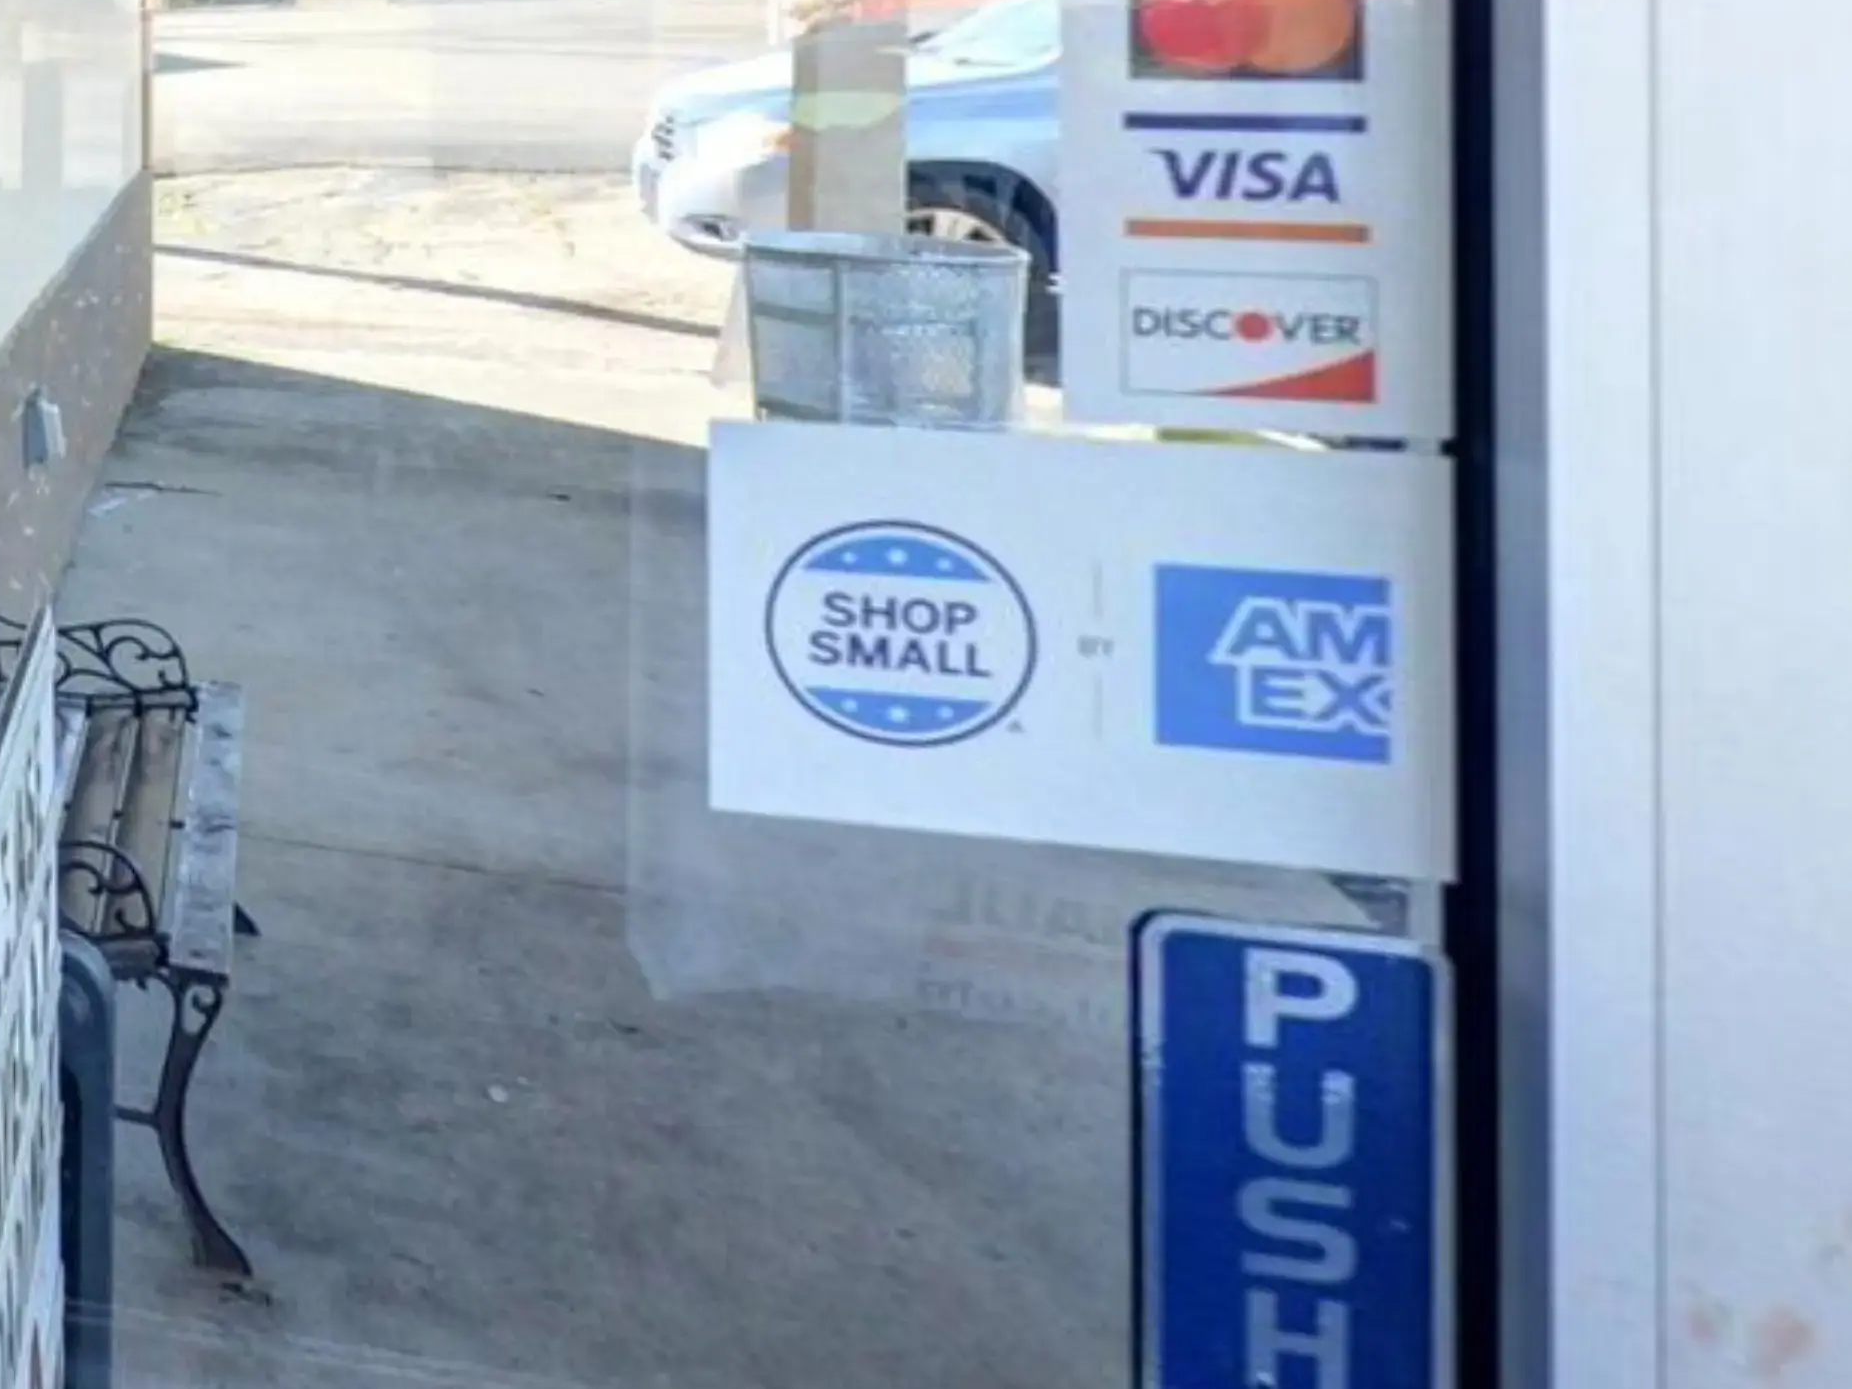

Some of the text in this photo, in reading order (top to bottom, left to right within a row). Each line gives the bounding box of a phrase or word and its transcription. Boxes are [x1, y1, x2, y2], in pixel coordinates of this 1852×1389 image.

[1151, 148, 1340, 203] VISA
[1131, 305, 1362, 347] DISCOVER
[822, 591, 977, 635] SHOP
[1228, 606, 1391, 667] AM
[807, 631, 994, 680] SMALL
[1236, 946, 1359, 1389] PUSH
